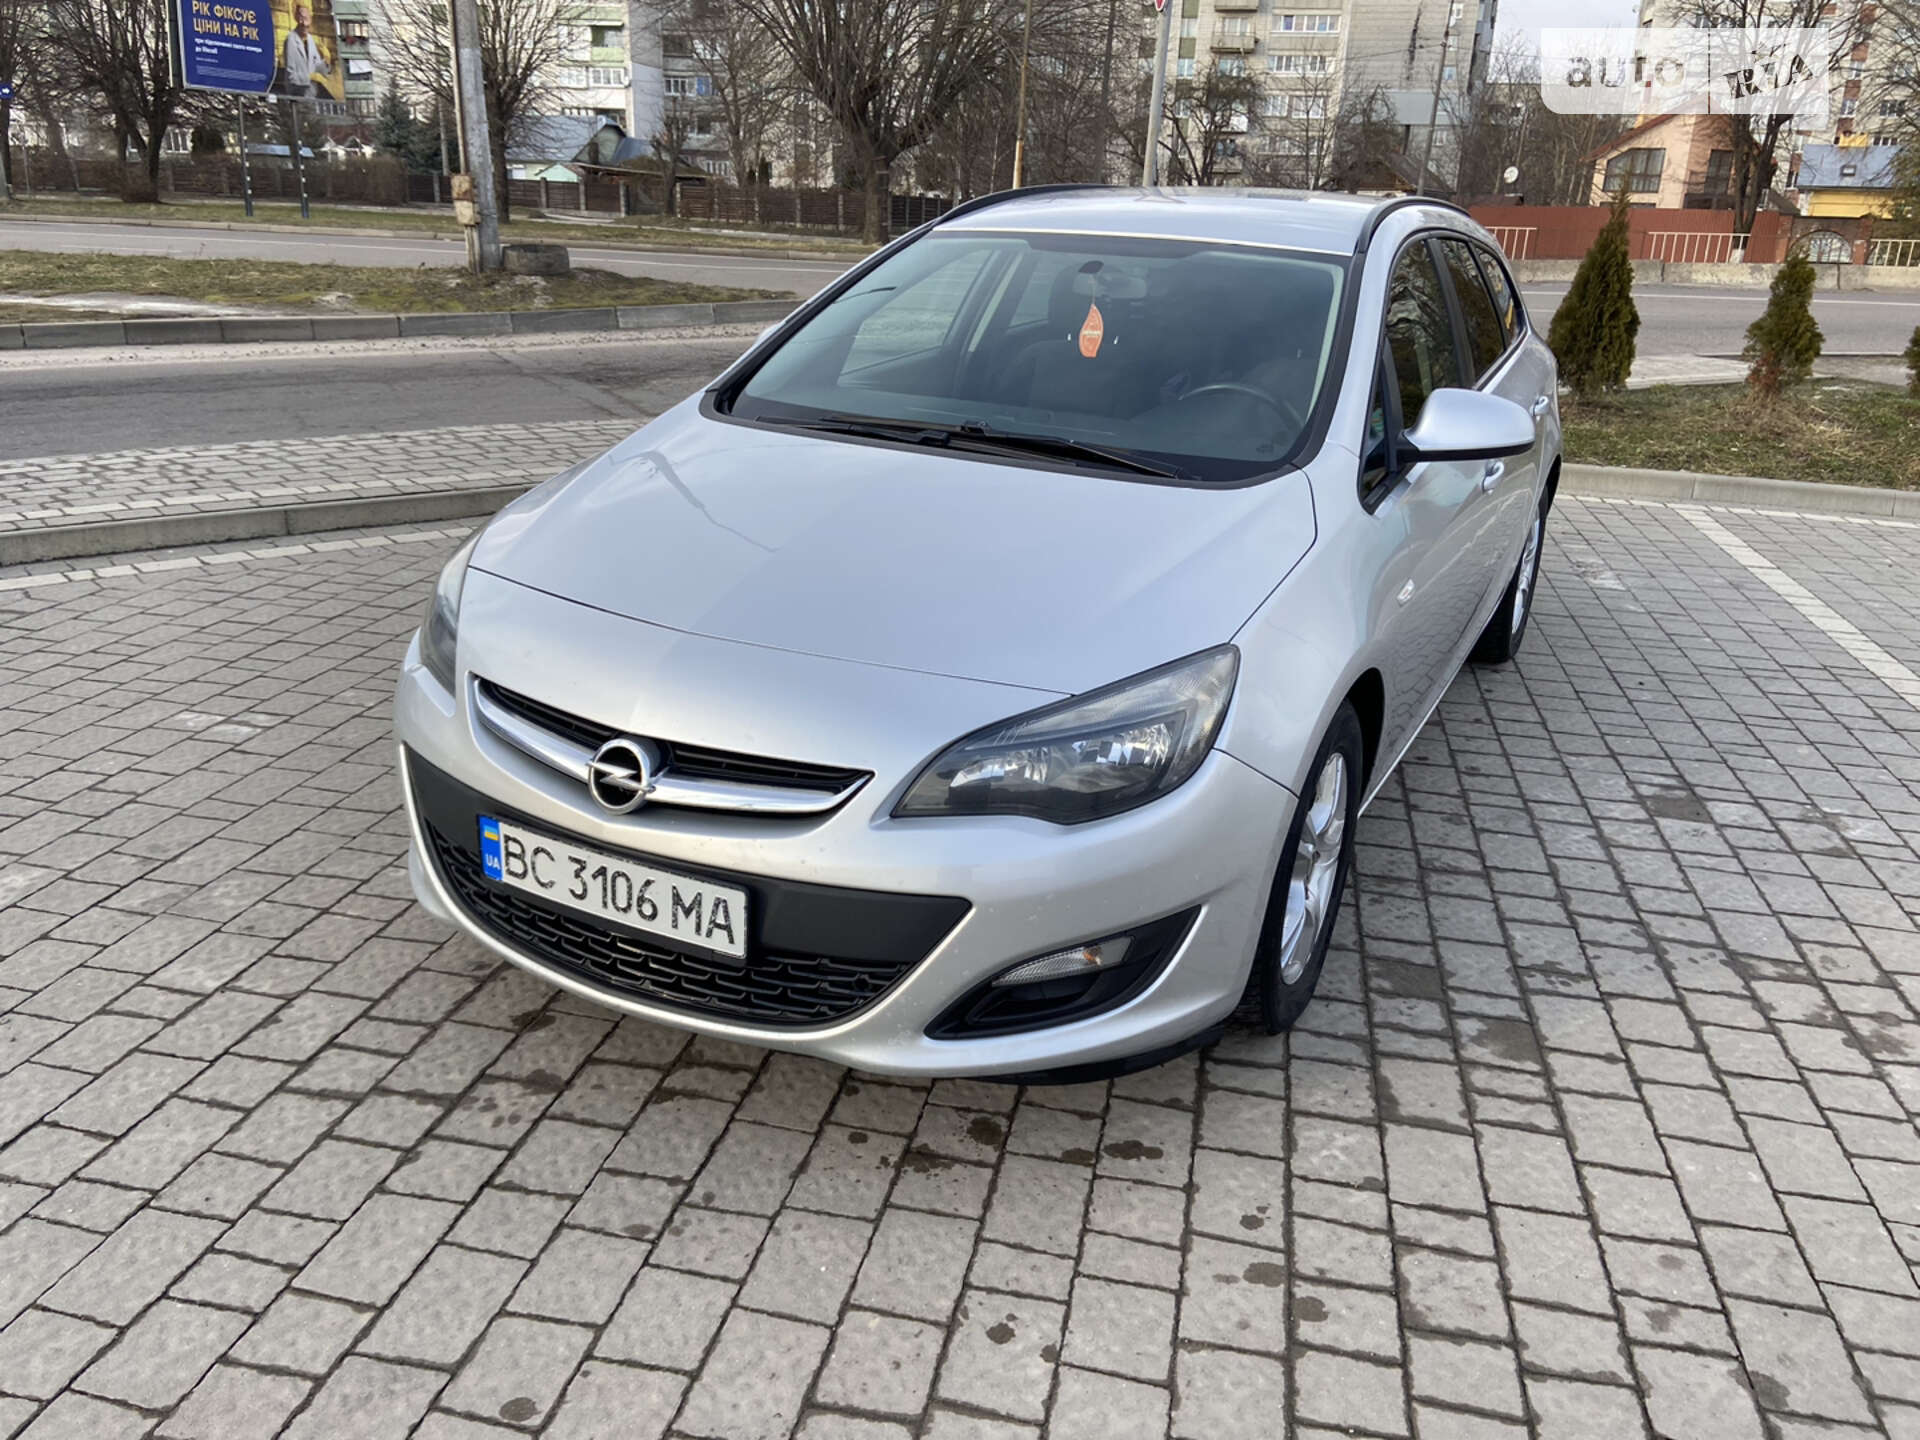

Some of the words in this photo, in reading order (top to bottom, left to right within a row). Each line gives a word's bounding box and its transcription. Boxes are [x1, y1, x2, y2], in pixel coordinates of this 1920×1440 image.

[192, 0, 211, 16] РІК
[213, 4, 257, 24] ФІКСУЄ
[193, 17, 221, 34] ЦІНИ
[224, 22, 240, 37] НА
[242, 25, 259, 40] РІК
[486, 853, 500, 870] UA
[503, 834, 556, 889] BC
[567, 855, 659, 922] 3106
[672, 882, 736, 945] MA
